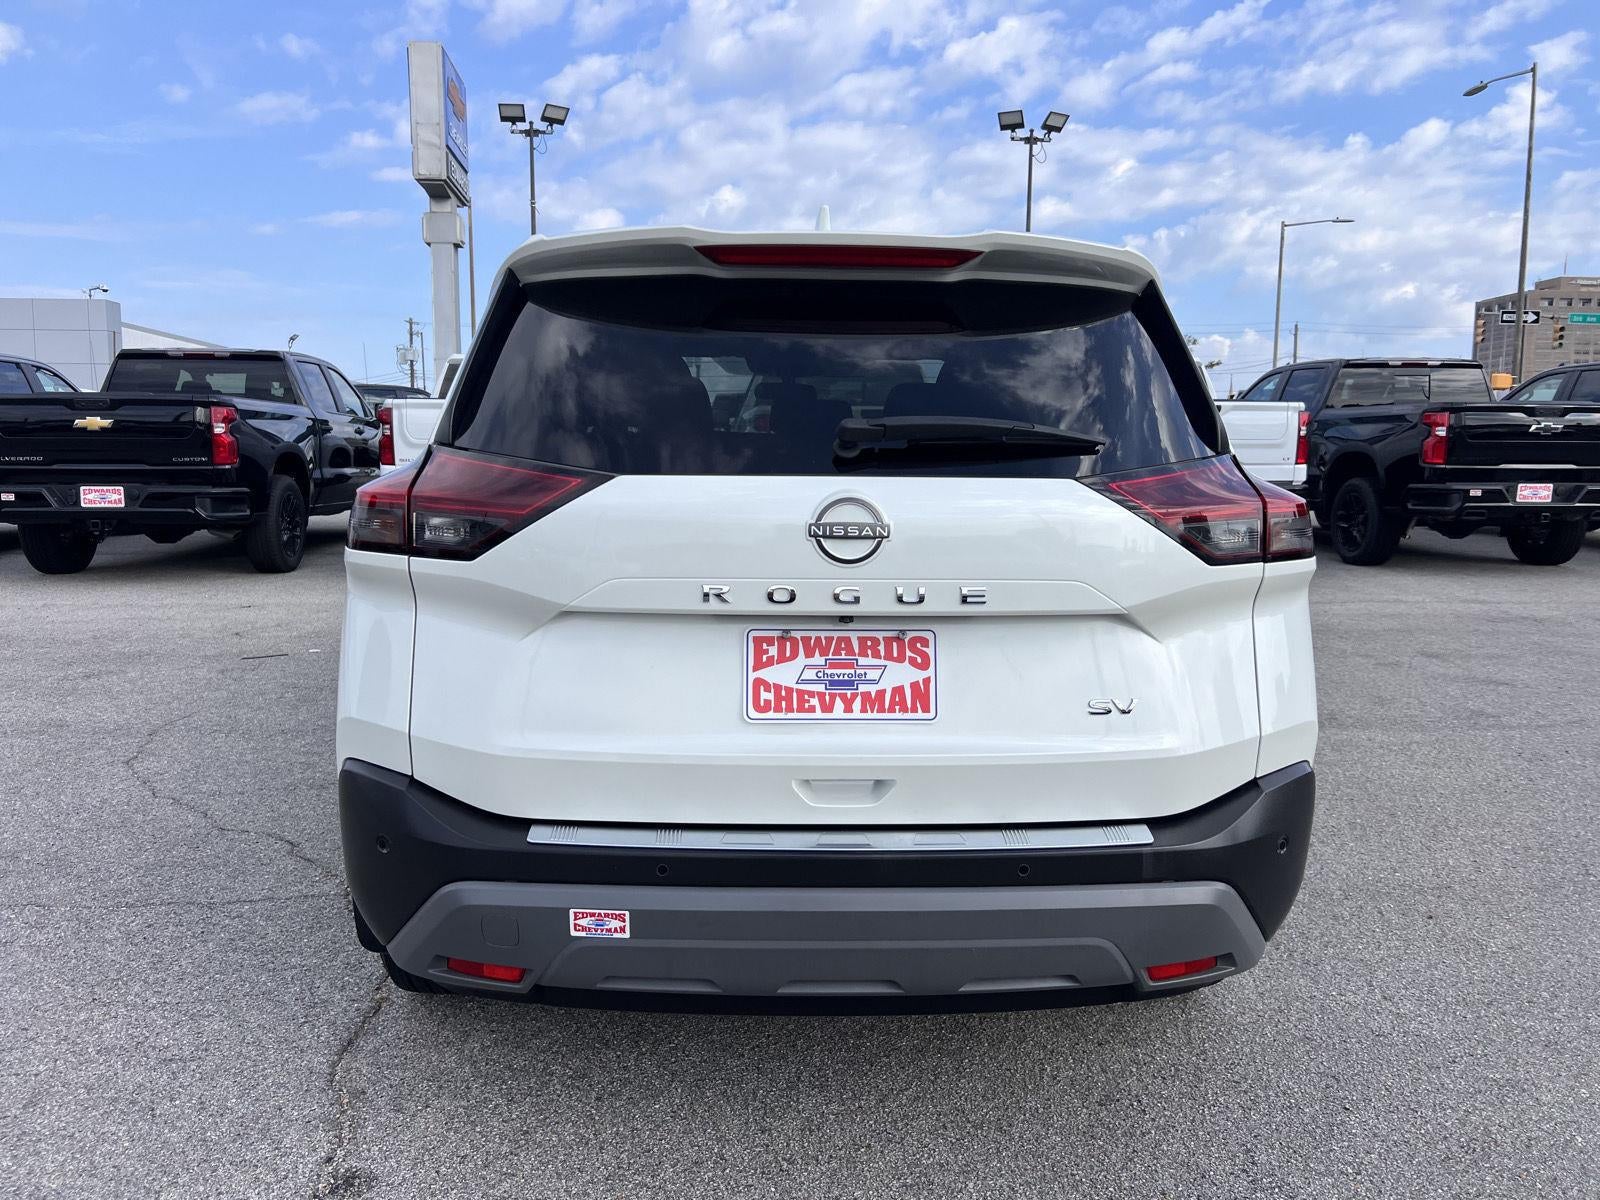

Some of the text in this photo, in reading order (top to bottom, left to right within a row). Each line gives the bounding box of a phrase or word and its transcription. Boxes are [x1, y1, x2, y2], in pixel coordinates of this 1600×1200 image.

[82, 488, 122, 496] EDWARDS
[810, 525, 888, 537] NISSAN
[702, 584, 988, 604] ROGUE
[752, 635, 931, 673] EDWARDS
[815, 669, 868, 680] Chevrolet
[752, 676, 931, 713] CHEVYMAN
[1087, 698, 1137, 715] SV
[573, 911, 626, 923] EDWARDS
[573, 922, 626, 934] CHEVYMAN
